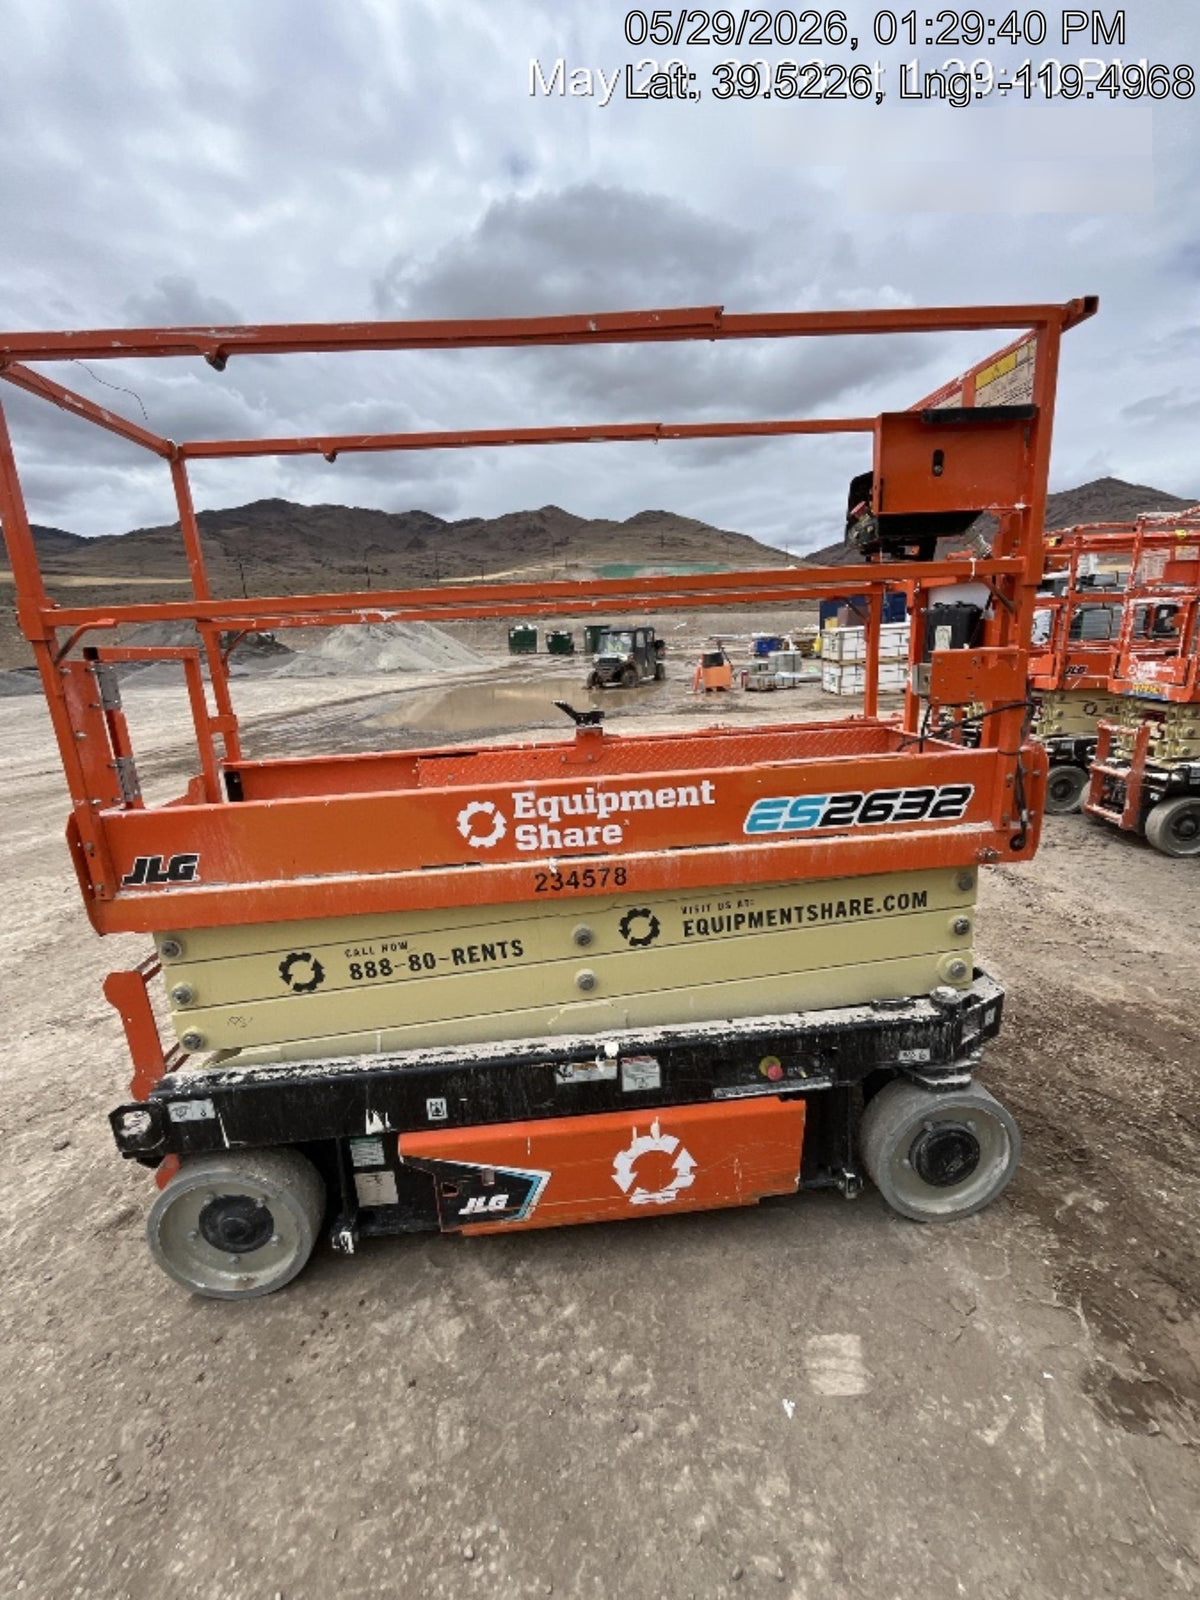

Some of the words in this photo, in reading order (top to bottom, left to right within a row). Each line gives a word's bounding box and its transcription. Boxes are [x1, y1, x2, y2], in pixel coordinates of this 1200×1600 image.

[511, 780, 716, 822] Equipment
[743, 783, 975, 834] ES2632
[515, 823, 624, 850] Share
[121, 853, 201, 887] JLG
[534, 867, 628, 892] 234578
[681, 903, 711, 914] VISIT
[718, 901, 732, 910] US
[683, 890, 928, 937] EQUIPMENTSHARE.COM
[344, 947, 375, 958] CALL
[381, 940, 409, 953] NOW
[349, 939, 525, 980] 888-80-RENTS
[458, 1194, 509, 1215] JLG
